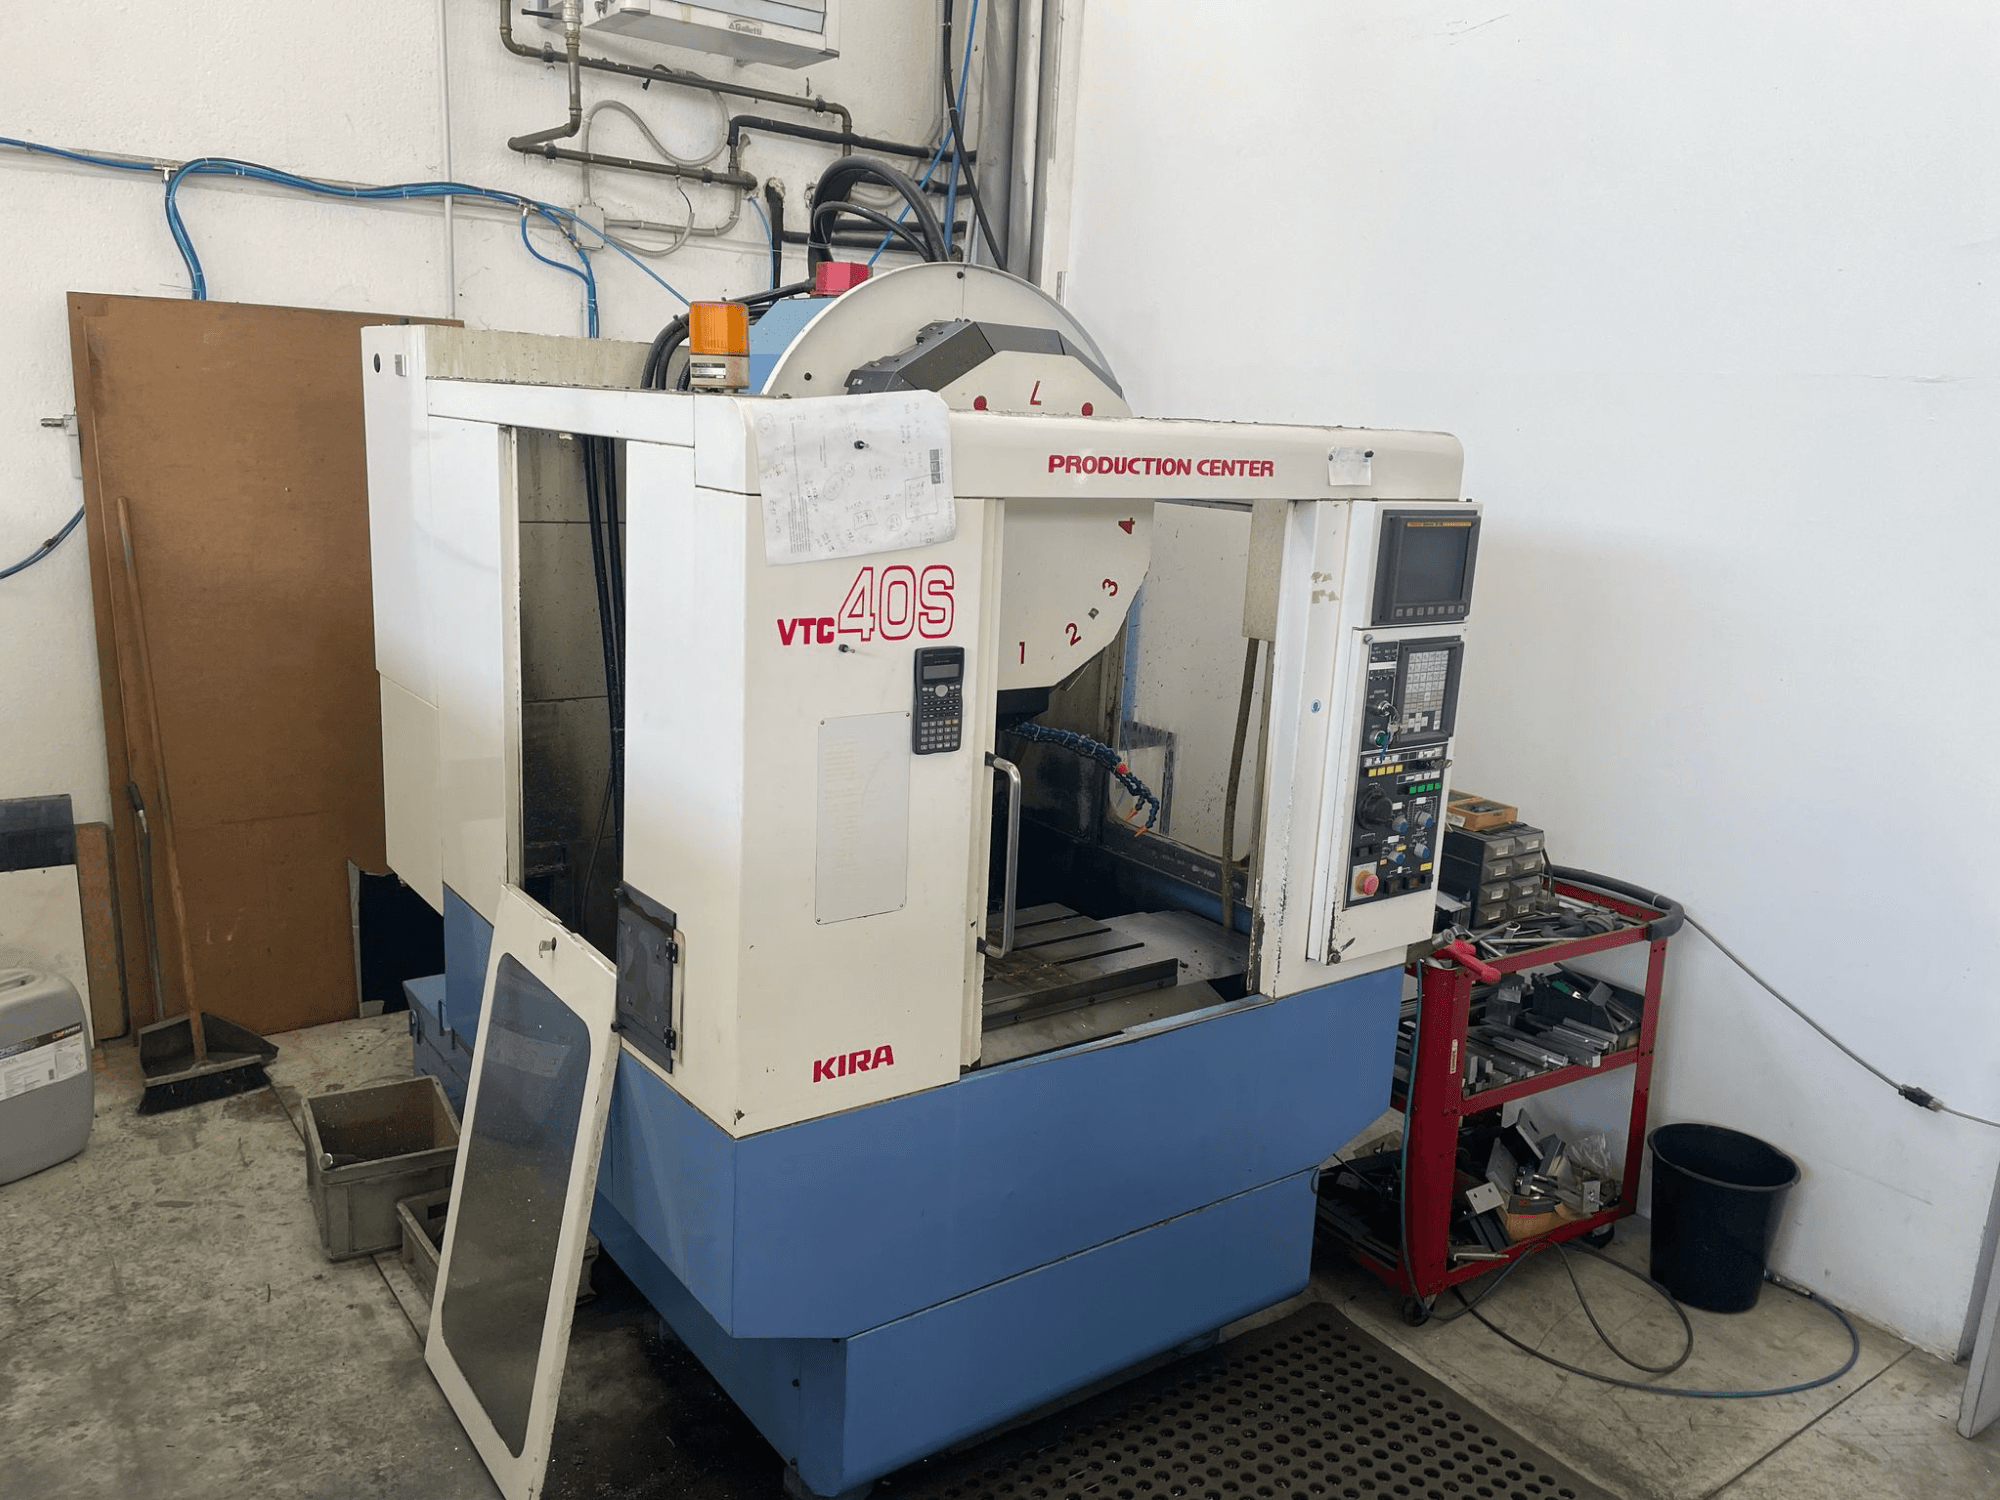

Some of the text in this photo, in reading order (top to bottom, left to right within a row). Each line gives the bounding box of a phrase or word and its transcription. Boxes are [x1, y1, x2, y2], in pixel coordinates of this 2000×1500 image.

[1048, 454, 1274, 477] PRODUCTION CENTER
[1102, 578, 1118, 597] 3
[1065, 622, 1082, 646] 2
[1019, 641, 1026, 665] 1
[813, 1044, 895, 1083] KIRA
